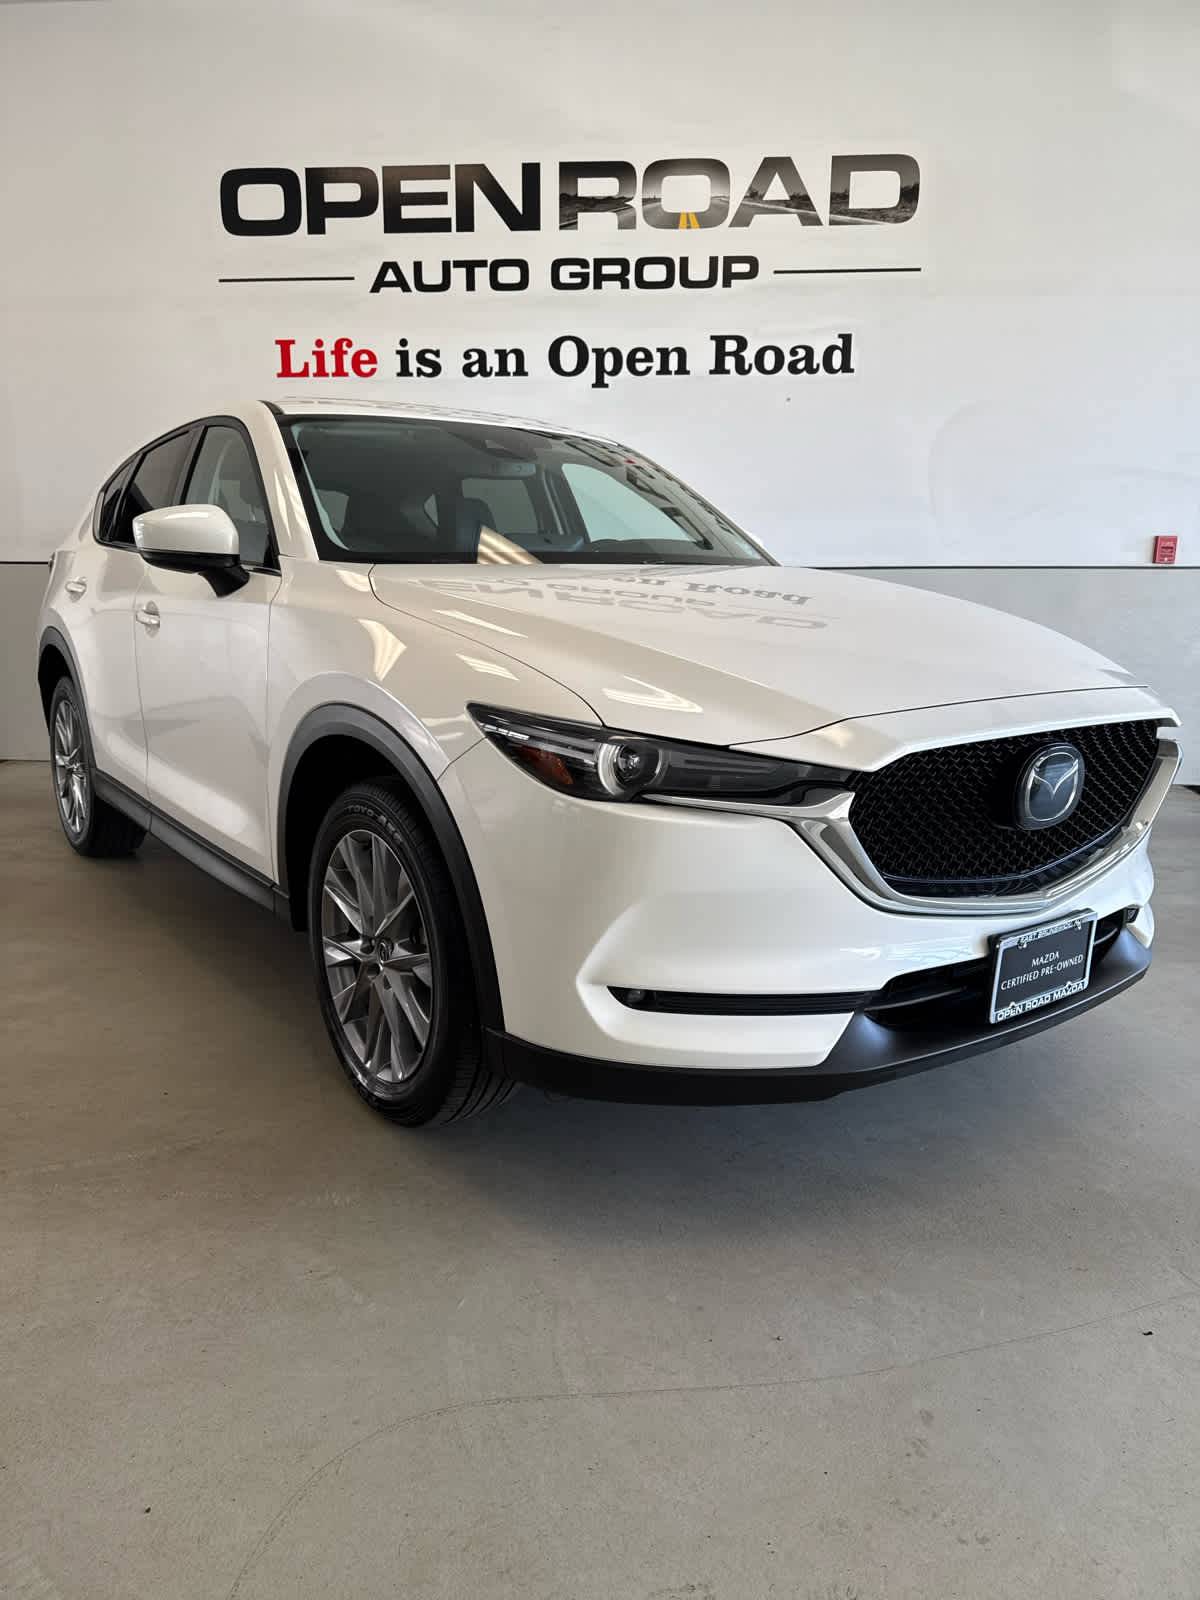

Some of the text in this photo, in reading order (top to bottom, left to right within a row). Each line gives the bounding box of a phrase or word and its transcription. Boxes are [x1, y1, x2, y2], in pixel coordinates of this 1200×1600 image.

[219, 153, 921, 237] OPEN ROAD
[369, 255, 760, 294] AUTO GROUP
[274, 333, 855, 389] Life is an Open Road
[1001, 954, 1084, 990] CERTIFIED PRE-OWNED
[1031, 951, 1060, 967] MAZDA
[997, 981, 1085, 1021] OPEN ROAD MAZDA
